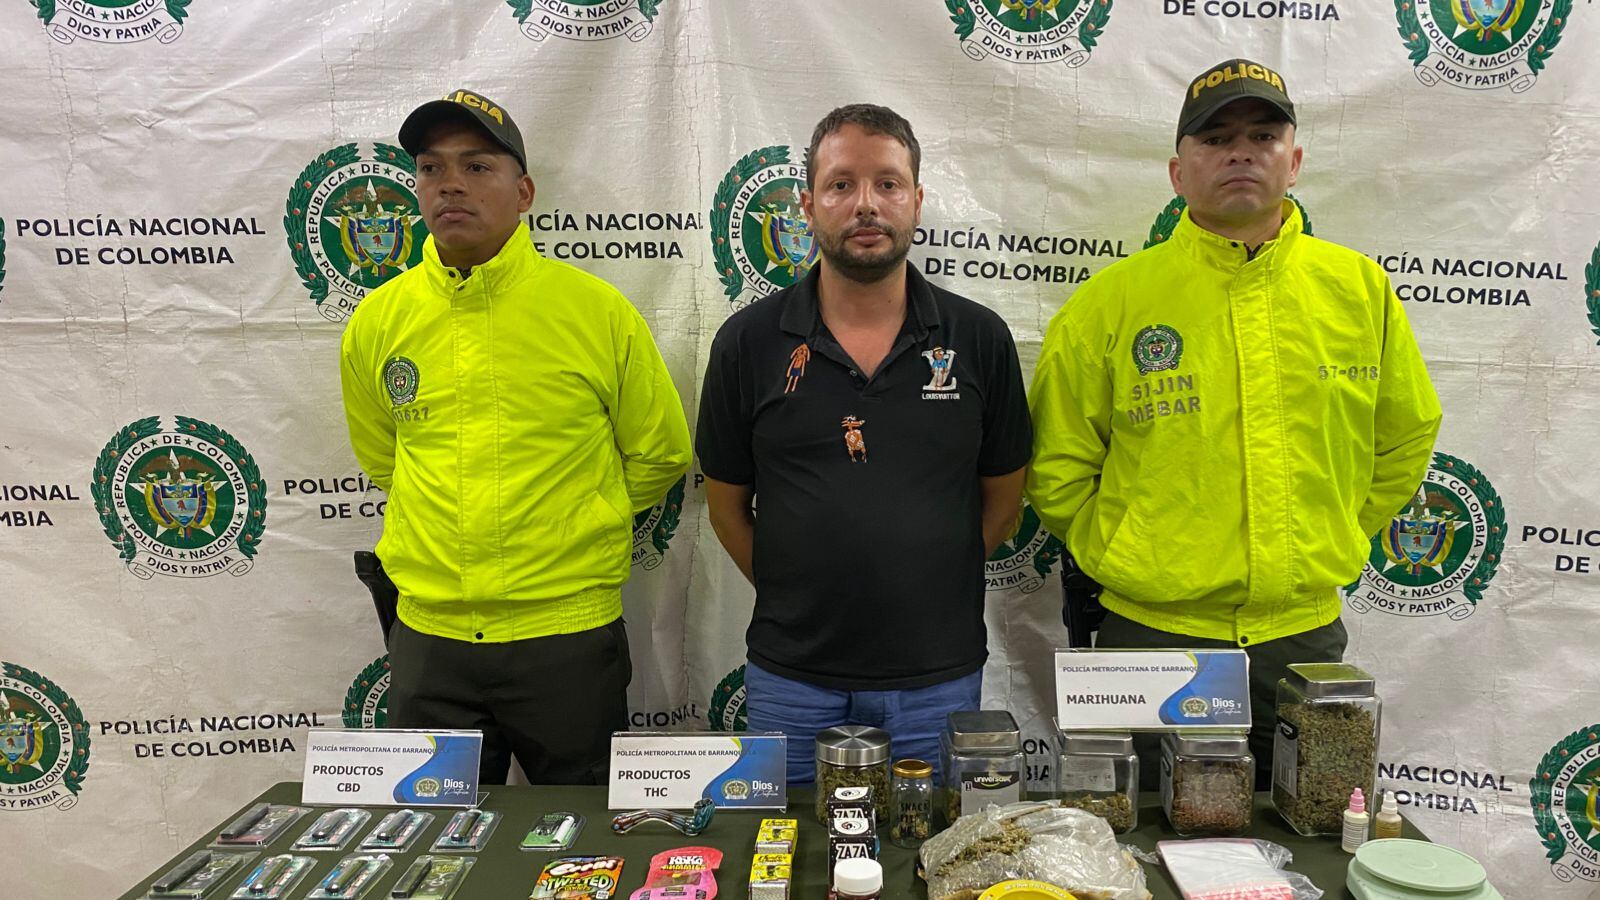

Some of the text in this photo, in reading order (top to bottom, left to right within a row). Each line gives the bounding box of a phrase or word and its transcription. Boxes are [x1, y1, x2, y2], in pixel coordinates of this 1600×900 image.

[113, 0, 155, 20] NACIO
[586, 0, 628, 18] NACIO
[1163, 0, 1340, 21] DE COLOMBIA
[67, 17, 161, 39] DIOS Y PATRIA
[541, 15, 633, 36] DIOS Y PATRIA
[1028, 6, 1088, 44] NACIONAL
[982, 35, 1072, 60] DIOS Y PATRIA
[1479, 25, 1542, 68] NACIONAL
[1435, 60, 1519, 86] DIOS Y PATRIA
[442, 92, 503, 125] LICIA
[361, 163, 380, 174] DE
[789, 167, 807, 177] DE
[16, 214, 266, 236] POLICÍA NACIONAL
[528, 209, 703, 231] ICÍA NACIONAL
[534, 241, 683, 259] E COLOMBIA
[911, 227, 1129, 258] OLICÍA NACIONAL
[55, 246, 235, 265] DE COLOMBIA
[1377, 252, 1568, 280] ICÍA NACIONAL
[925, 257, 1091, 284] DE COLOMBIA
[1395, 284, 1531, 307] COLOMBIA
[1132, 375, 1193, 401] SIJIN
[1127, 396, 1201, 425] MEBAR
[163, 435, 181, 445] DE
[197, 442, 246, 506] COLOMBIA
[0, 485, 79, 501] IONAL
[0, 511, 53, 526] MBIA
[320, 503, 352, 519] DE
[1450, 480, 1486, 548] COLOMBIA
[633, 509, 662, 544] IONAL
[1522, 525, 1600, 547] POLIC
[189, 520, 243, 560] NACIONAL
[147, 555, 233, 575] DIOS Y PATRIA
[632, 548, 647, 562] RIA
[986, 538, 1046, 572] NACIONAL
[1555, 555, 1590, 573] DE
[986, 571, 1027, 587] PATRIA
[1412, 563, 1475, 597] NACIONAL
[1366, 591, 1456, 613] DIOS Y PATRIA
[1067, 694, 1146, 704] MARIHUANA
[1212, 697, 1235, 708] Dios
[24, 686, 70, 744] COLOMBIA
[100, 712, 325, 736] POLICÍA NACIONAL
[631, 703, 700, 727] CIONAL
[135, 738, 296, 758] DE COLOMBIA
[17, 758, 69, 794] NACIONAL
[312, 765, 384, 776] PRODUCTOS
[618, 770, 691, 780] PRODUCTOS
[1378, 762, 1512, 792] NACIONAL
[337, 782, 361, 793] CBD
[443, 778, 464, 789] Dios
[644, 787, 668, 797] THC
[752, 780, 773, 790] Dios
[8, 800, 16, 808] Y
[20, 790, 61, 808] PATRIA
[1381, 788, 1478, 814] OMBIA
[1571, 859, 1597, 879] DIOS
